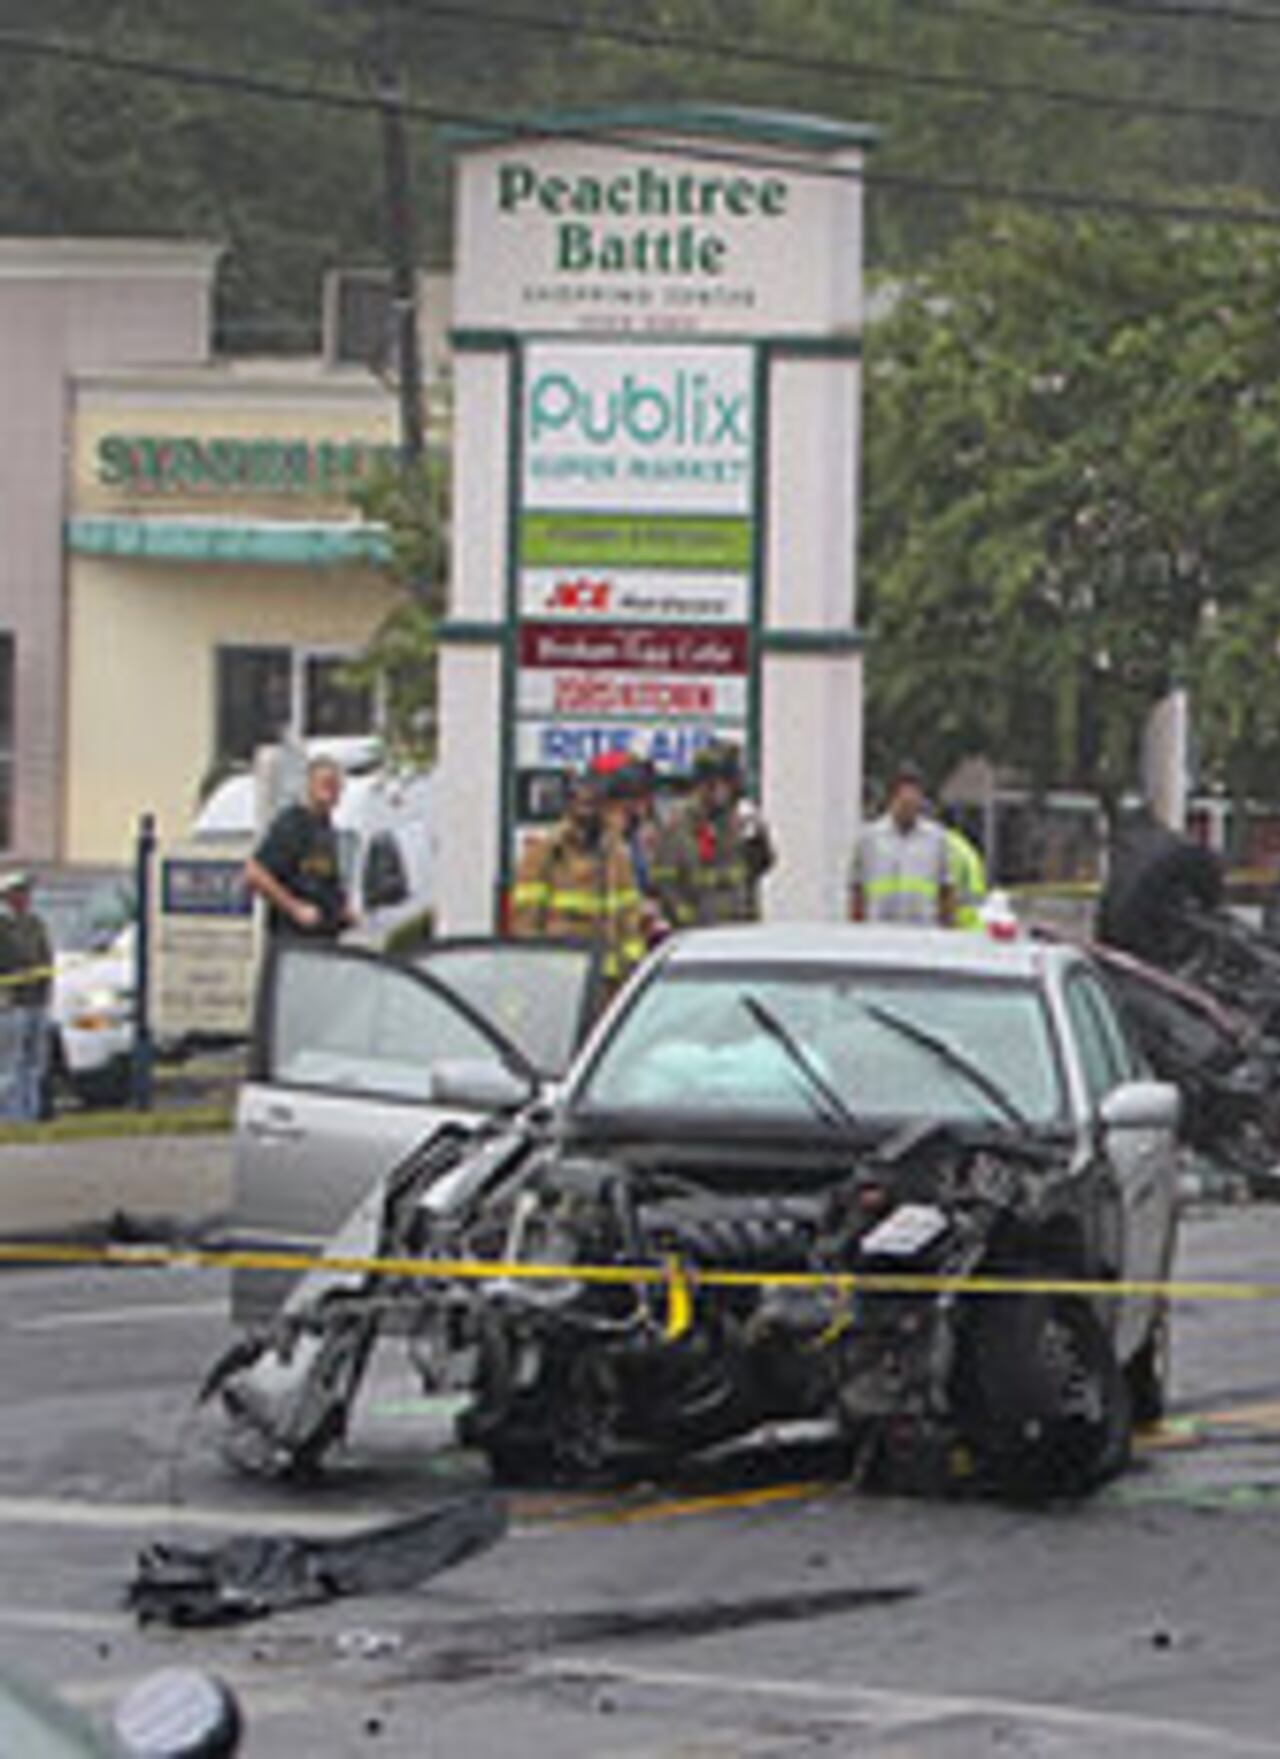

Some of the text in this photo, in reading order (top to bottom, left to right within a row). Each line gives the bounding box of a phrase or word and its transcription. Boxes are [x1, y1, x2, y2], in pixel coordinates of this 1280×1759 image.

[496, 162, 789, 217] Peachtree
[557, 222, 728, 275] Battle
[530, 370, 748, 446] Publix
